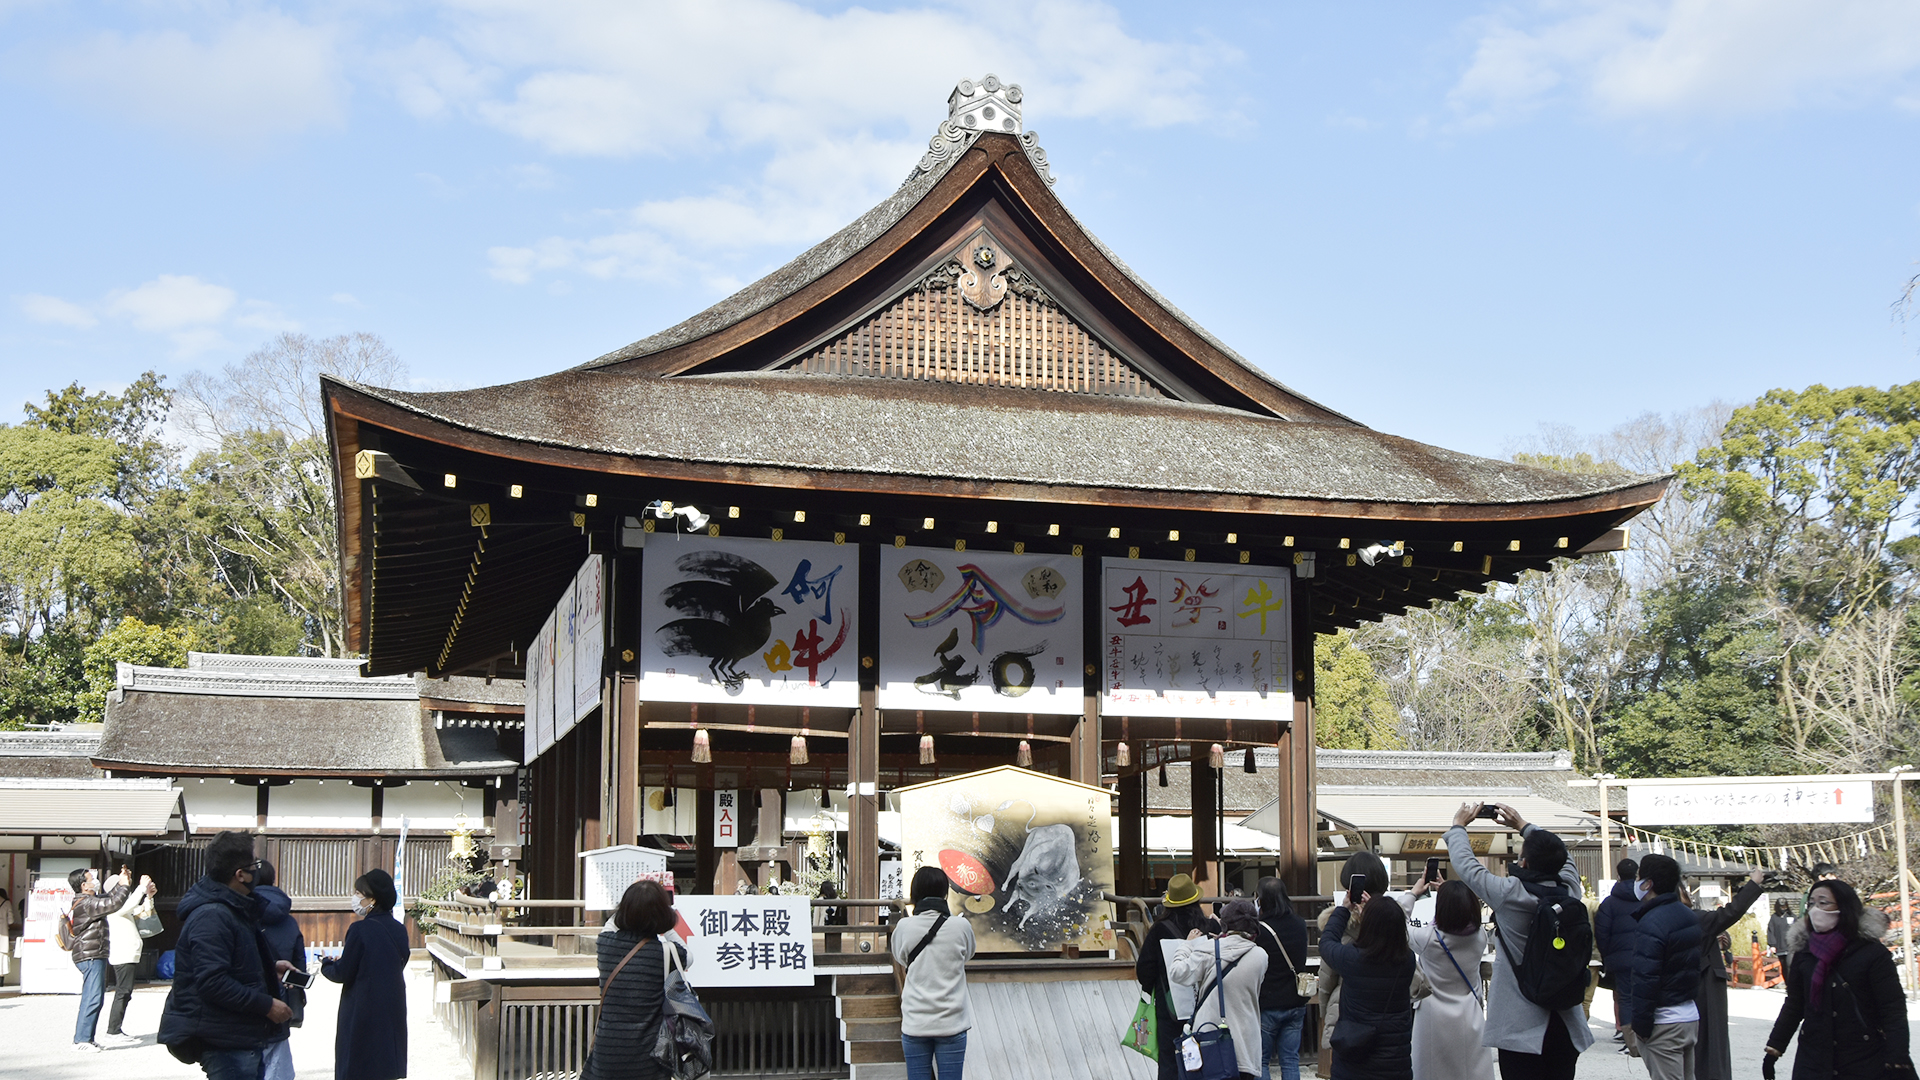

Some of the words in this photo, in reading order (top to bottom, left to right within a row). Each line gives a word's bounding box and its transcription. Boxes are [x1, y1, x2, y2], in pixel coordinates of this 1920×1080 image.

[1236, 578, 1283, 636] 牛
[699, 908, 791, 937] 御本殿
[716, 941, 807, 971] 参拝路
